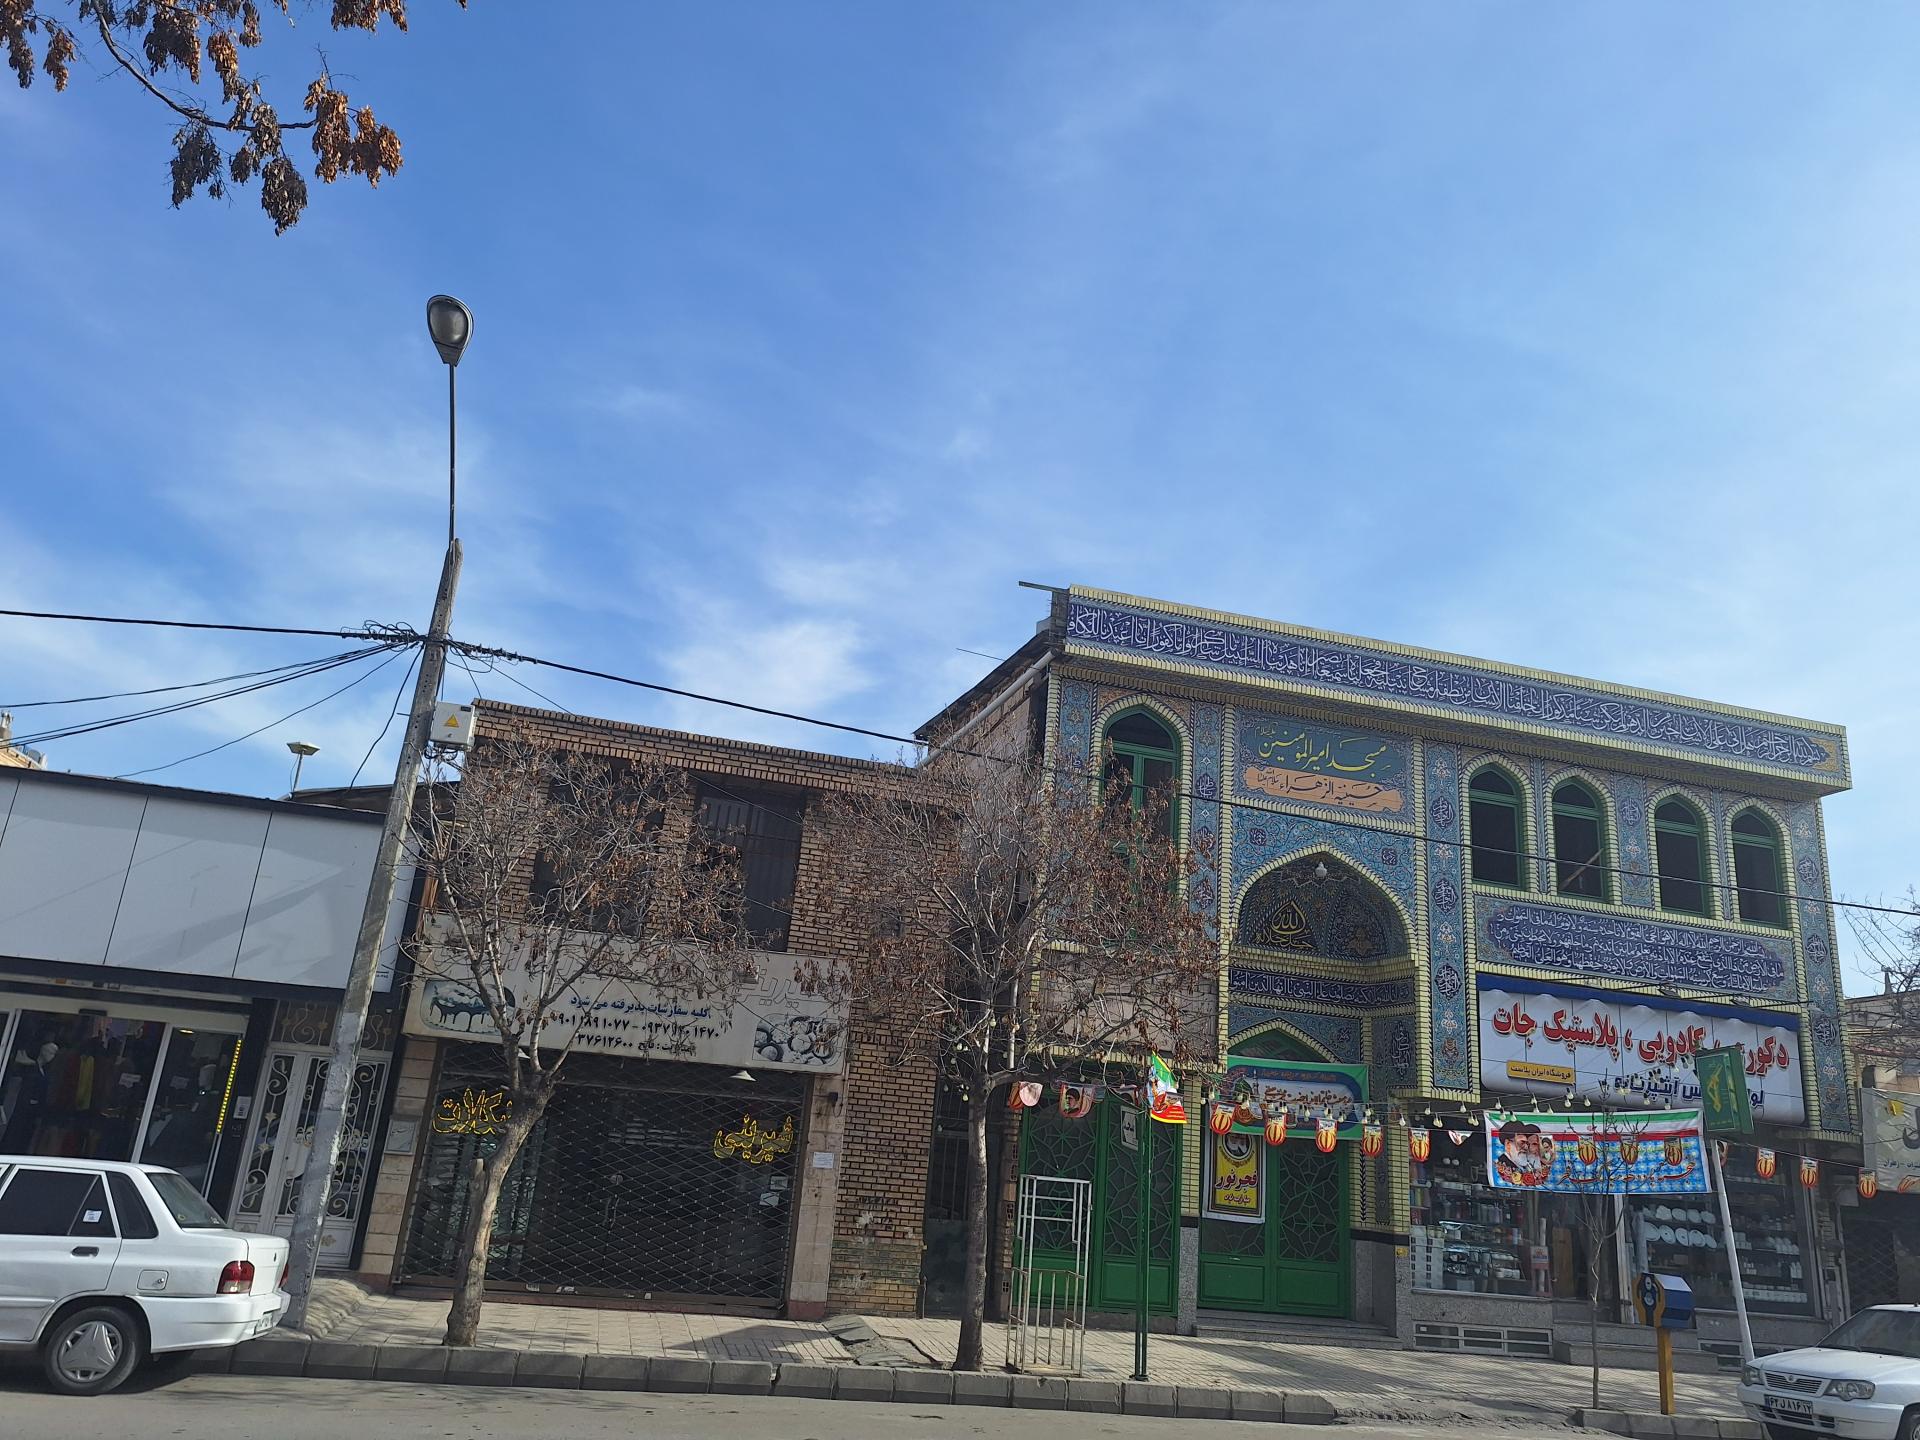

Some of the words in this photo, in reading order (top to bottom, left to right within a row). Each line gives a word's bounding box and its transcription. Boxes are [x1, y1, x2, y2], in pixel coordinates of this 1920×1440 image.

[1300, 741, 1330, 770] امیر
[1326, 737, 1387, 777] مسجد
[570, 995, 591, 1009] شود
[592, 1001, 609, 1011] می
[690, 1005, 711, 1018] کلیه
[1492, 1000, 1538, 1048] جات
[1542, 1008, 1619, 1062] پلاستیک
[1637, 1025, 1706, 1067] کادویی
[1530, 1067, 1546, 1078] ایران
[1546, 1068, 1572, 1080] فروشگاه
